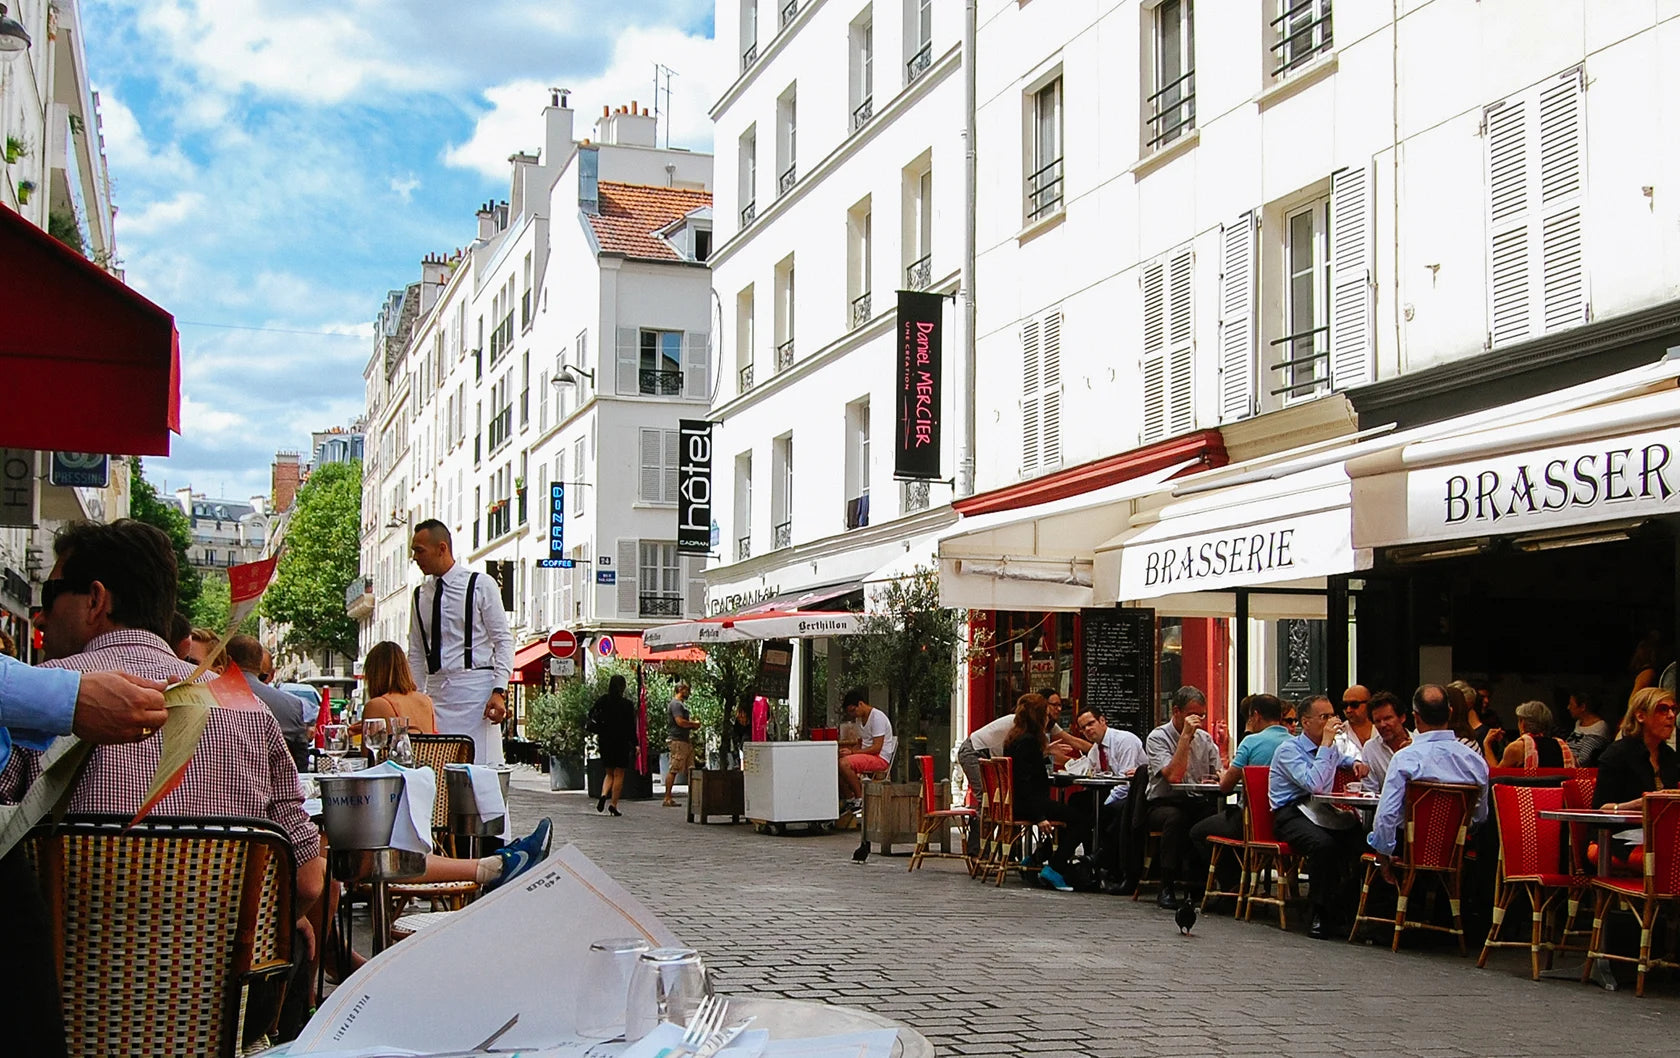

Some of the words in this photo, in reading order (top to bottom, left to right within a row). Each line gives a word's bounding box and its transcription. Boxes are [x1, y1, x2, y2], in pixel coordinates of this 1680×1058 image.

[916, 321, 935, 367] Daniel
[915, 370, 937, 448] MERCIER
[54, 471, 105, 485] PRESSING
[679, 426, 711, 531] hôtel
[1444, 440, 1680, 524] BRASSER
[552, 486, 564, 551] DINER
[542, 559, 572, 567] COFFEE
[1144, 528, 1295, 587] BRASSERIE
[799, 620, 847, 633] Berthillon
[526, 879, 545, 892] CLER
[353, 994, 370, 1014] VILLE
[346, 1013, 356, 1023] DE
[333, 1022, 350, 1041] PARIS
